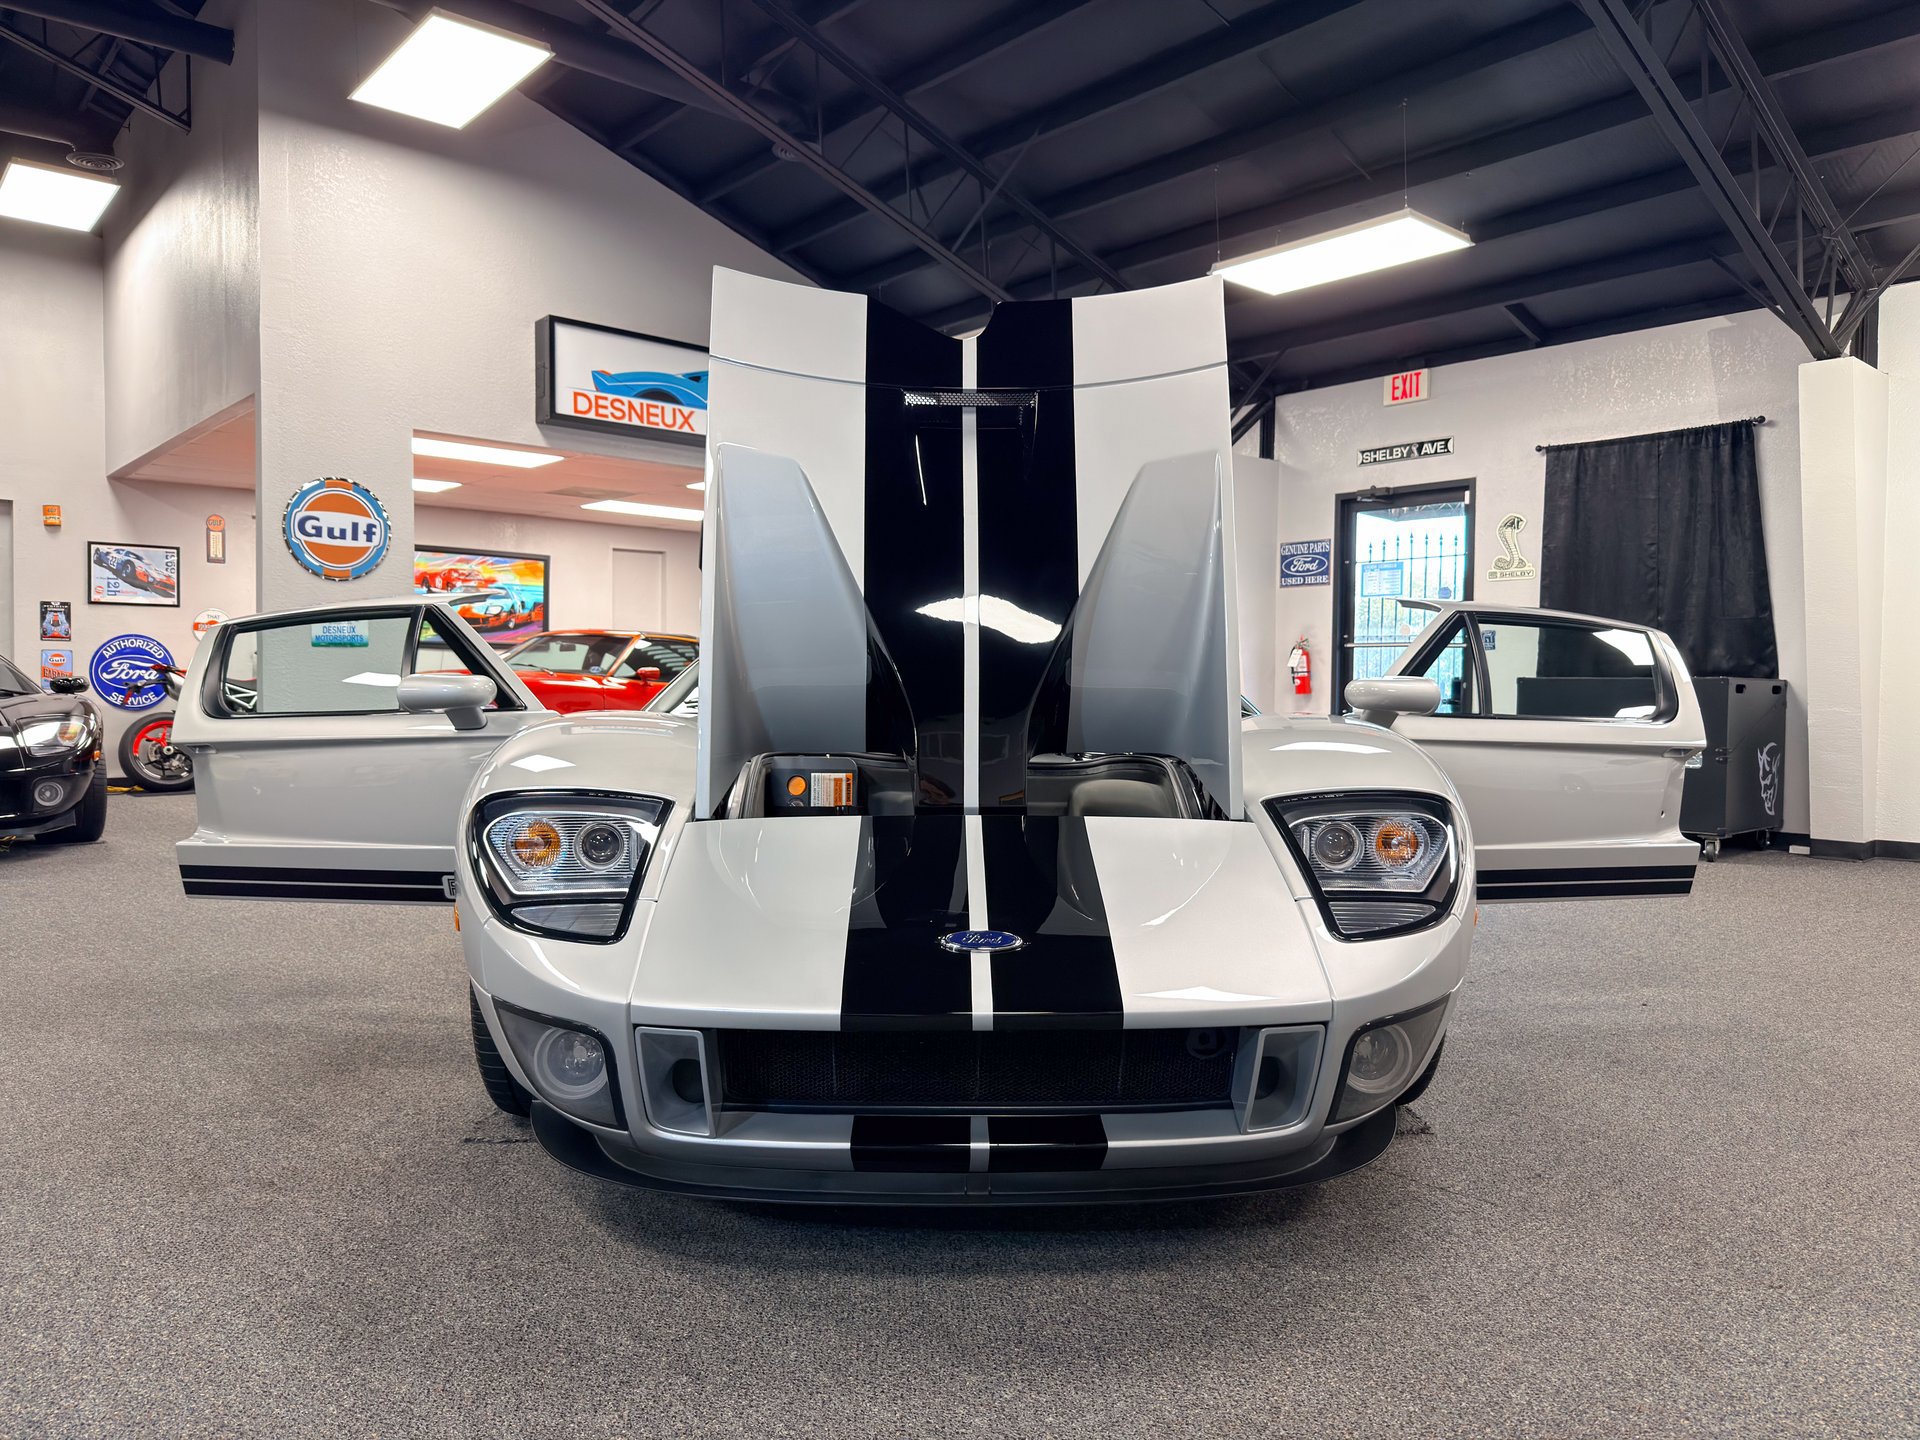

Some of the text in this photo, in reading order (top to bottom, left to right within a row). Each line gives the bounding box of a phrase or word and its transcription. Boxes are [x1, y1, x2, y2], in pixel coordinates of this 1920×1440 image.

[1391, 371, 1421, 401] EXIT
[573, 391, 695, 432] DESNEUX
[1363, 441, 1447, 463] SHELBY AVE.
[297, 515, 377, 543] Gulf
[1281, 541, 1330, 555] GENUINE PARTS
[1290, 557, 1319, 571] Ford
[1281, 575, 1328, 585] USED HERE
[322, 625, 356, 634] DESNEUX
[102, 638, 165, 659] AUTHORIZED
[962, 933, 1002, 945] Ford
